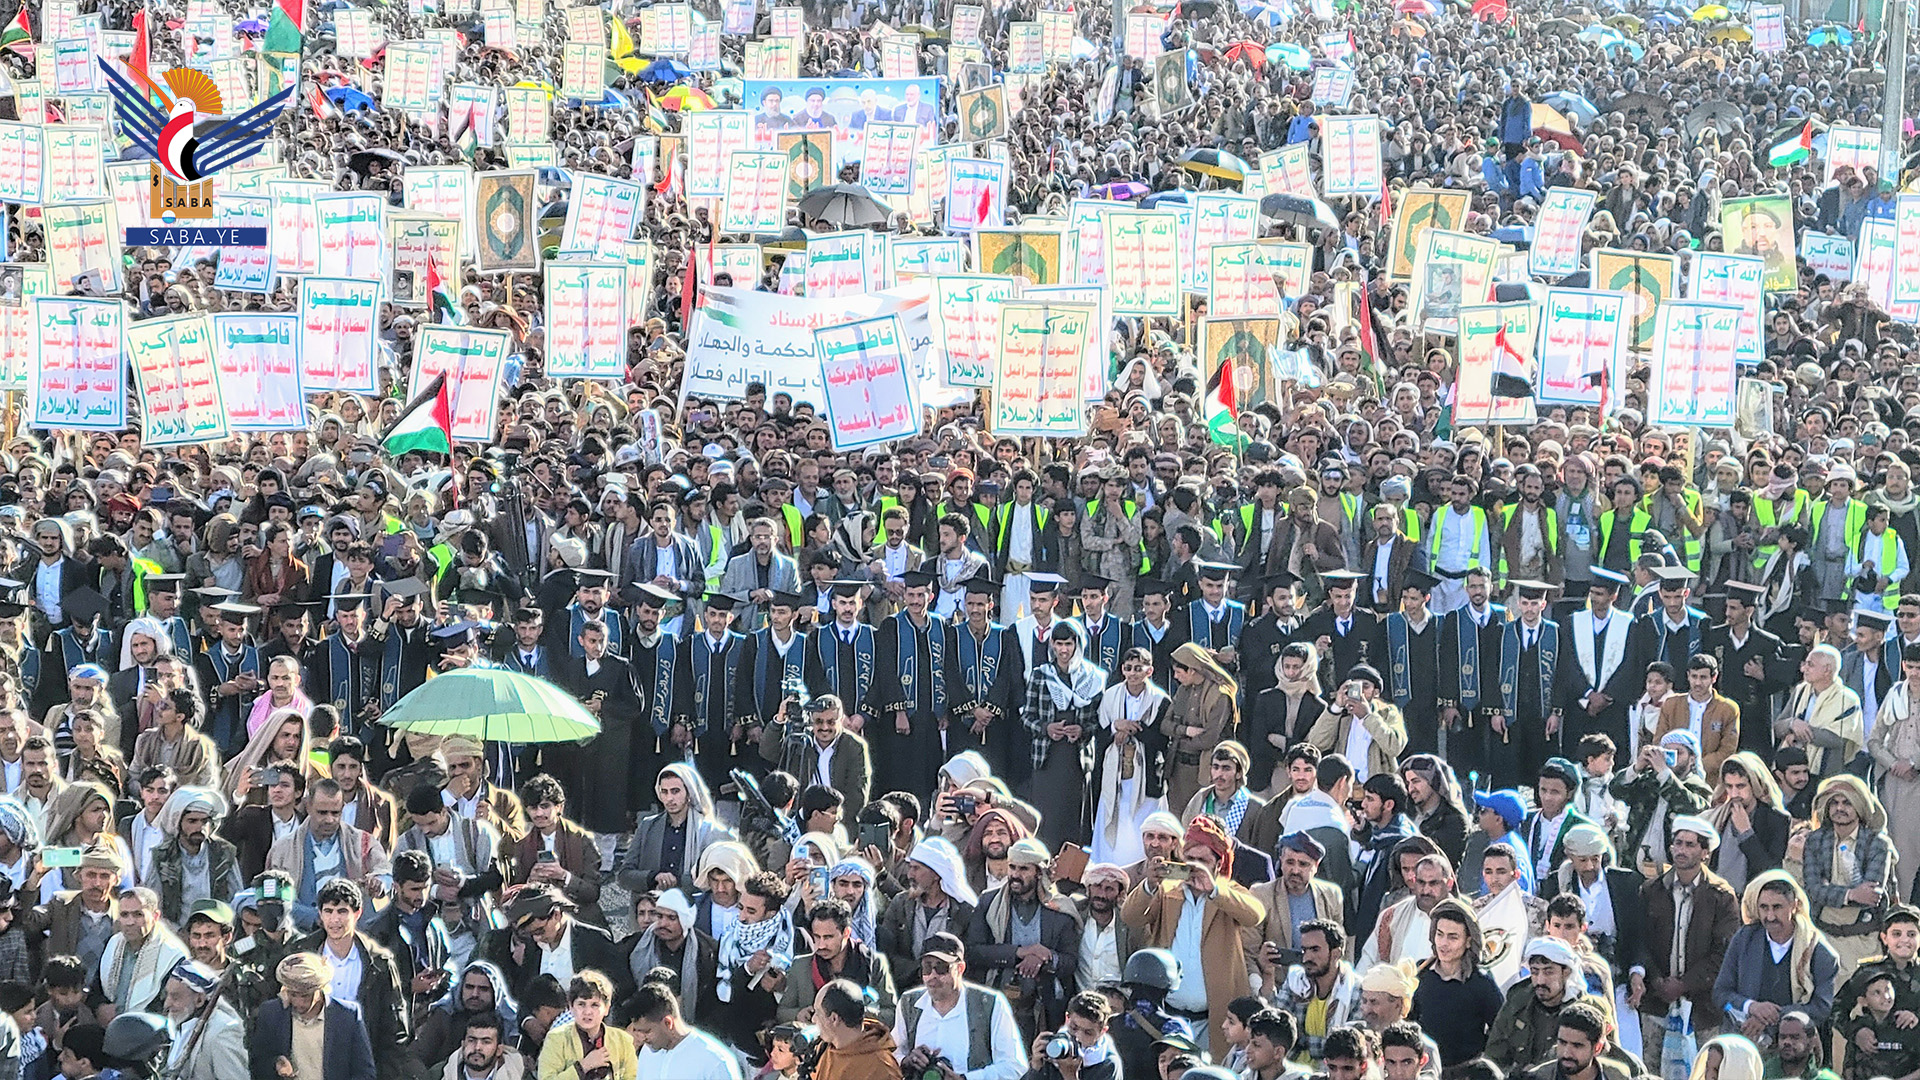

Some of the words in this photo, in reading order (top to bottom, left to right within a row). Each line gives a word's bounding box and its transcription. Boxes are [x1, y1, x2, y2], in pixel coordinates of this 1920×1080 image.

[49, 209, 103, 232] قاطعوا
[320, 204, 378, 229] قاطعوا
[810, 242, 861, 267] قاطعوا
[1432, 239, 1491, 265] قاطعوا
[307, 286, 373, 310] قاطعوا
[90, 311, 118, 327] الله
[1551, 300, 1617, 323] قاطعوا
[179, 325, 206, 345] الله
[222, 320, 290, 351] قاطعوا
[1007, 312, 1065, 340] أكبر
[1059, 317, 1083, 335] الله
[425, 334, 499, 358] قاطعوا
[820, 326, 894, 361] قاطعوا
[1045, 408, 1077, 427] النصر
